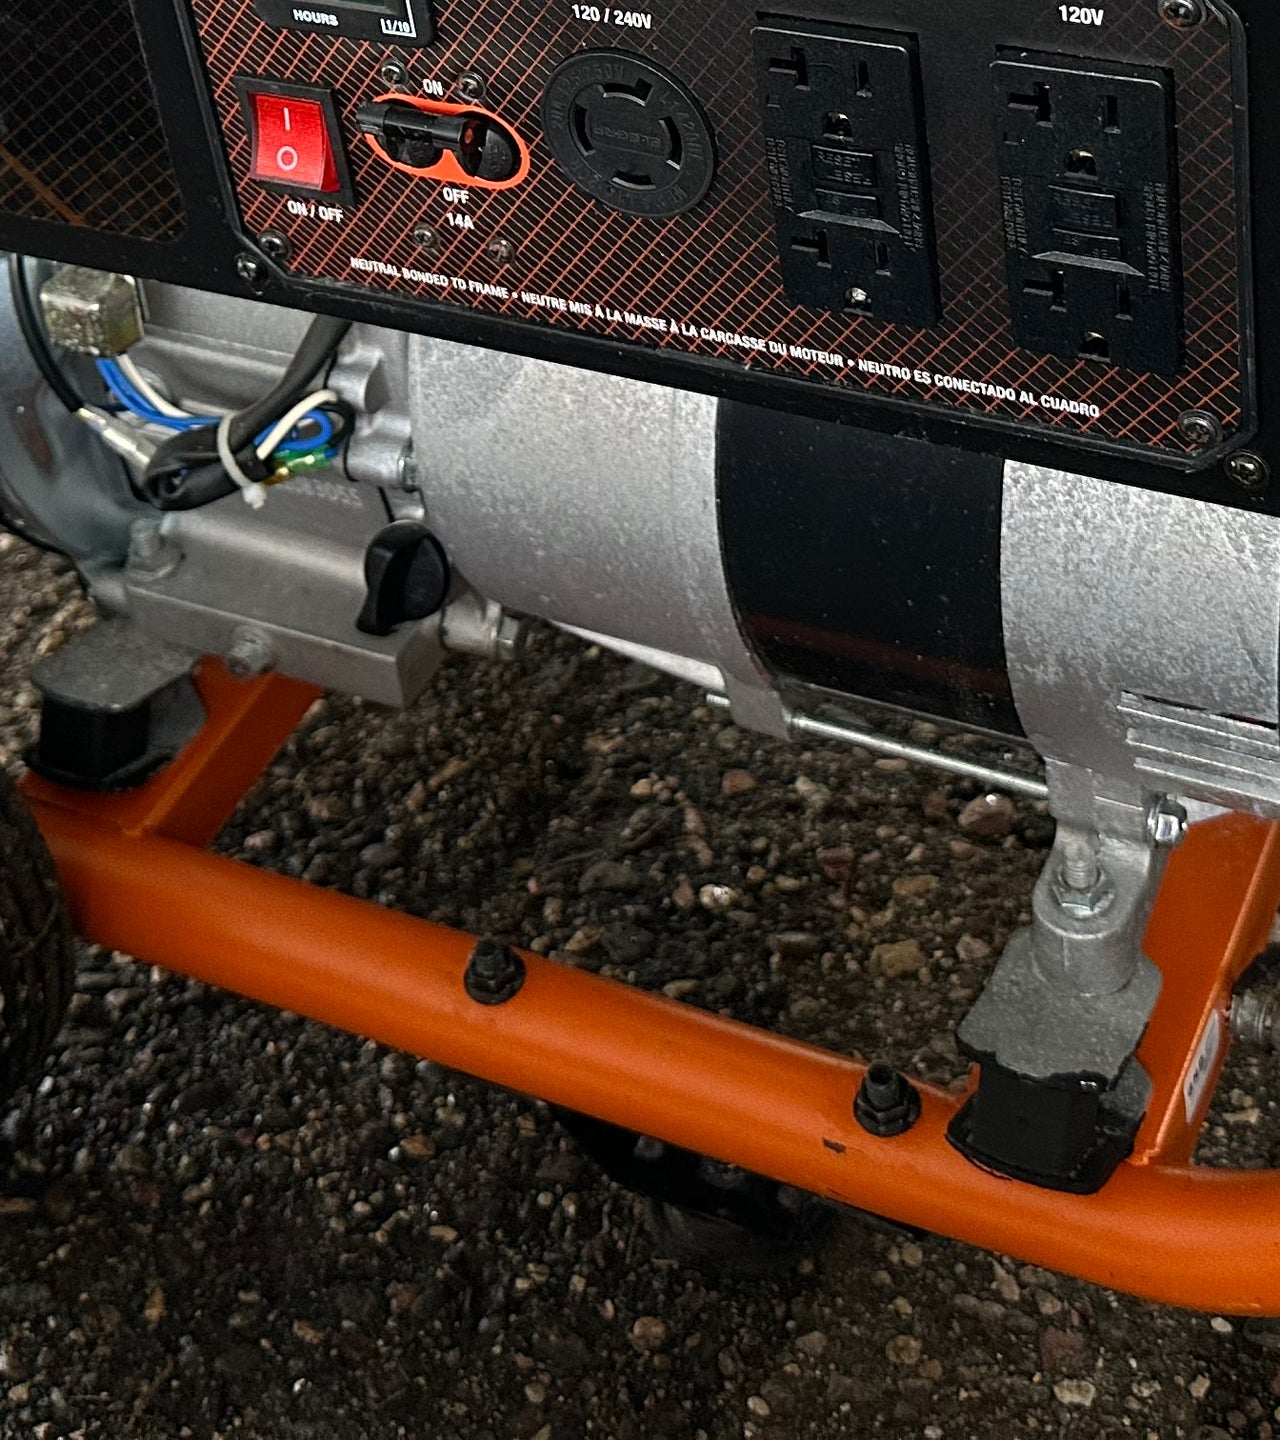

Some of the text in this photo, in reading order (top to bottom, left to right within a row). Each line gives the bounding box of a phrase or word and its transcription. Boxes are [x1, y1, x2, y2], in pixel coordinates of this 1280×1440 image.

[292, 8, 339, 27] HOURS
[572, 4, 601, 23] 120
[614, 10, 652, 30] 240V
[1058, 4, 1104, 26] 120V
[422, 79, 444, 97] ON
[443, 187, 470, 205] OFF
[287, 200, 308, 216] ON
[318, 205, 344, 223] OFF
[447, 212, 475, 230] 14A
[350, 257, 401, 277] NEUTRAL
[402, 266, 449, 288] BONDED
[450, 276, 467, 291] TO
[469, 280, 508, 299] FRAME
[521, 291, 568, 312] NEUTRE
[569, 301, 592, 316] MIS
[606, 307, 623, 322] LA
[624, 311, 668, 332] MASSE
[681, 323, 699, 338] LA
[700, 327, 767, 352] CARCASSE
[768, 341, 788, 356] DU
[790, 346, 844, 368] MOTEUR
[858, 358, 912, 381] NEUTRO
[913, 369, 932, 385] ES
[934, 374, 1017, 401] CONECTADO
[1019, 390, 1039, 406] AL
[1041, 394, 1101, 418] CUADRO
